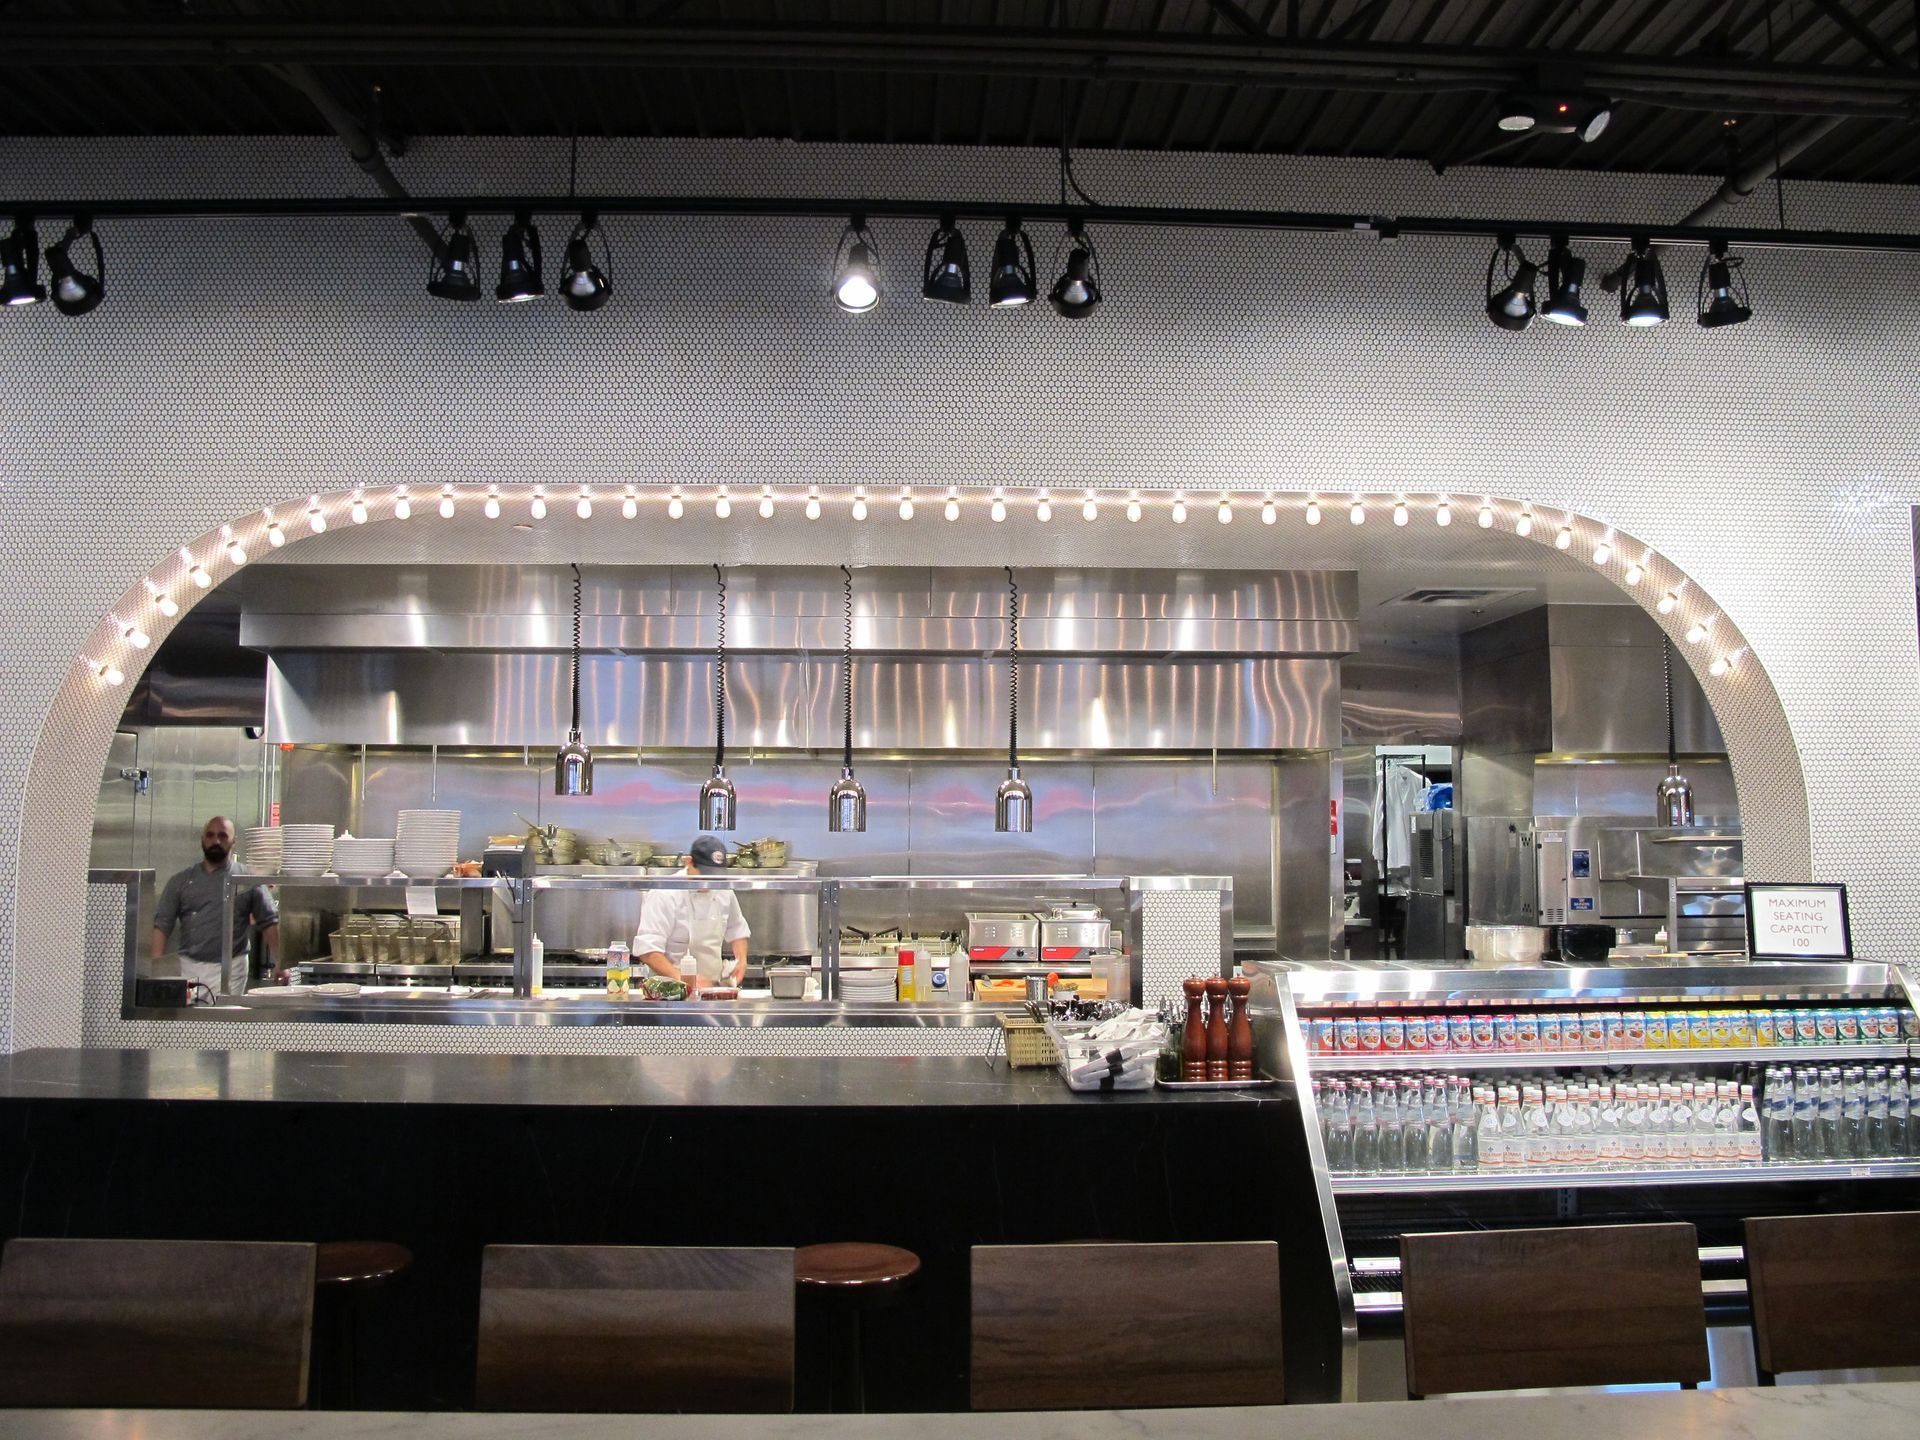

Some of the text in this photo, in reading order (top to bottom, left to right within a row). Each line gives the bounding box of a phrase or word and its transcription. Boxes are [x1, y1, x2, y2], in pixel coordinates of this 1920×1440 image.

[1769, 899, 1826, 908] MAXIMUM
[1774, 912, 1823, 921] SEATING
[1770, 925, 1828, 934] CAPACITY
[1793, 938, 1810, 947] 100
